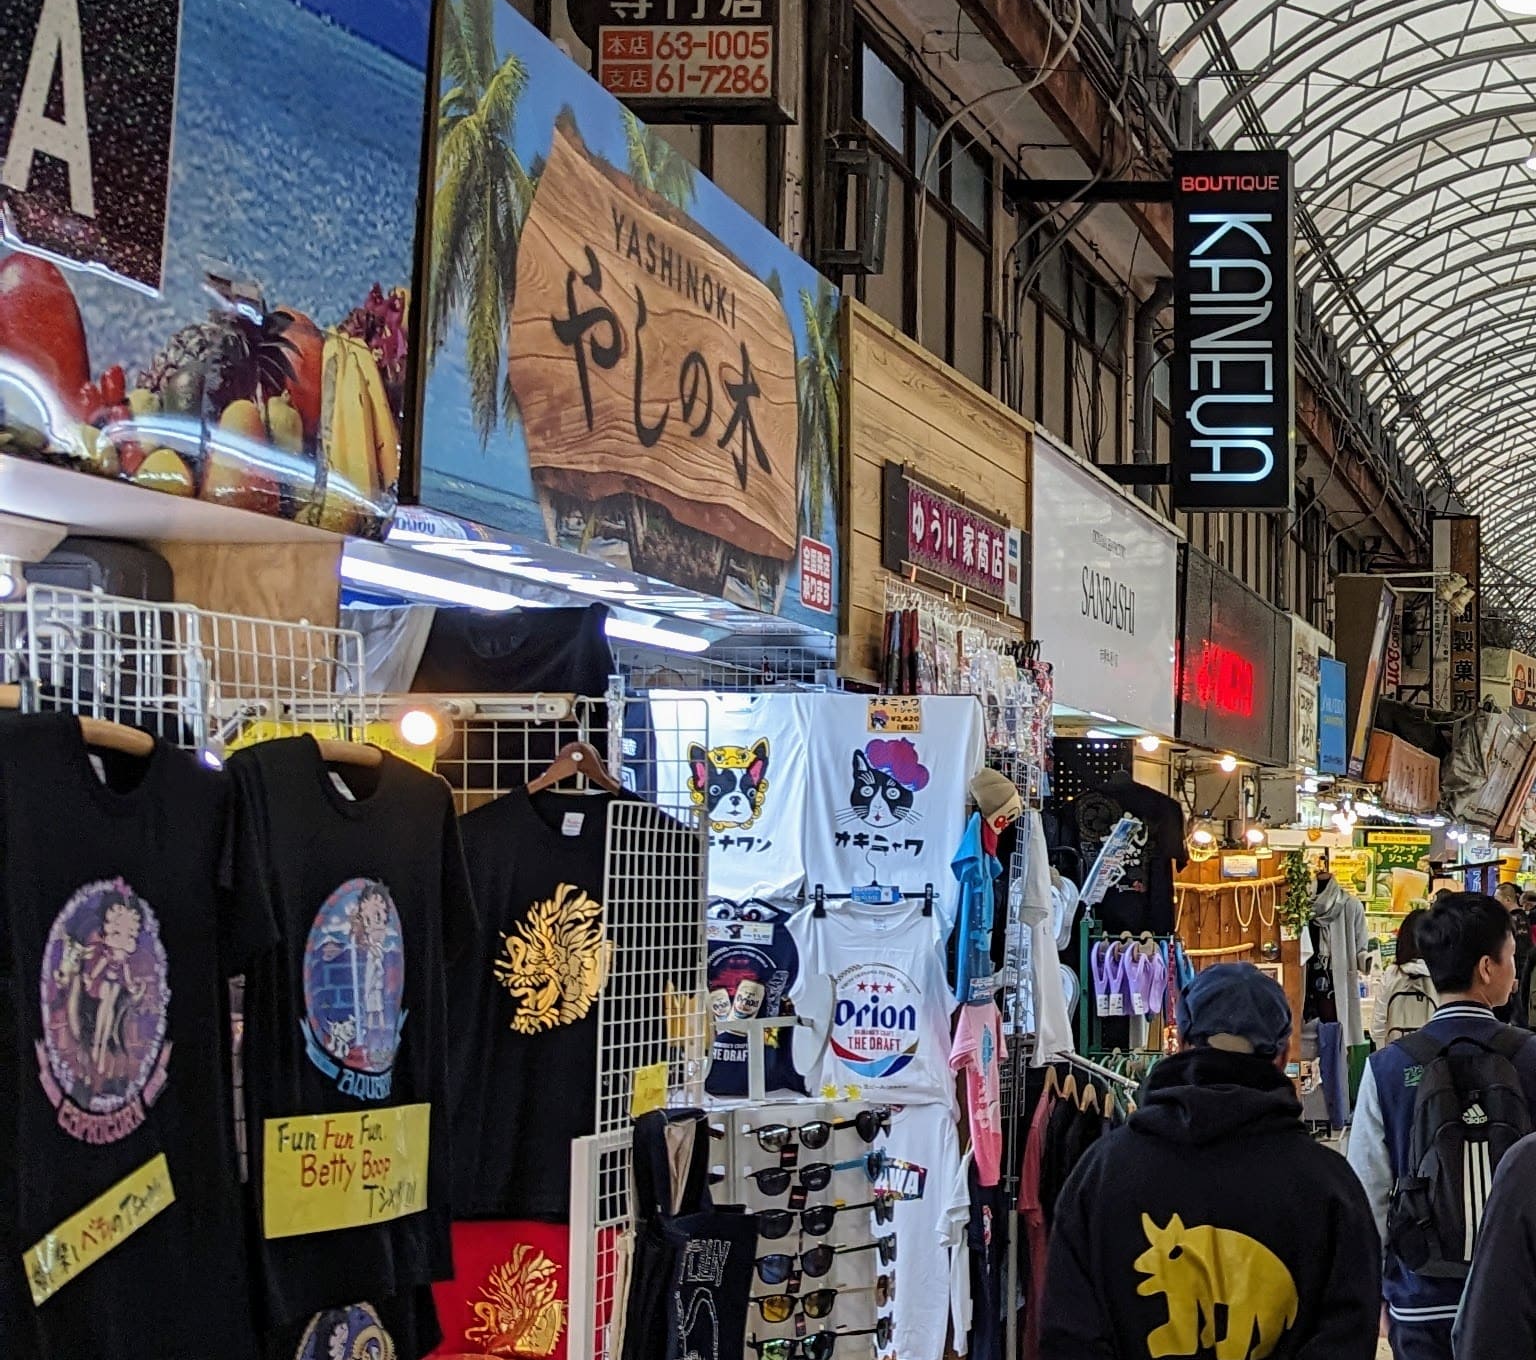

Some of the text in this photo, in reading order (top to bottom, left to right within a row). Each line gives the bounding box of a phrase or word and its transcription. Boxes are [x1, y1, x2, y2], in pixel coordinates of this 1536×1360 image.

[606, 31, 769, 61] 本店 63-1005
[655, 65, 768, 94] 61-7286
[1181, 175, 1280, 192] BOUTIQUE
[611, 207, 736, 329] YASHINOKI
[551, 243, 772, 491] やしの木
[912, 501, 1004, 578] ゆうり家商店
[1081, 566, 1135, 636] SANBASHI
[869, 697, 920, 707] オキニャワ
[835, 831, 924, 857] オキニャワ
[835, 995, 915, 1031] Orion
[724, 1049, 748, 1061] DRAF
[848, 1036, 901, 1051] THE DRAFT
[278, 1122, 317, 1153] Fun
[323, 1119, 354, 1150] Fun
[301, 1153, 356, 1192] Betty
